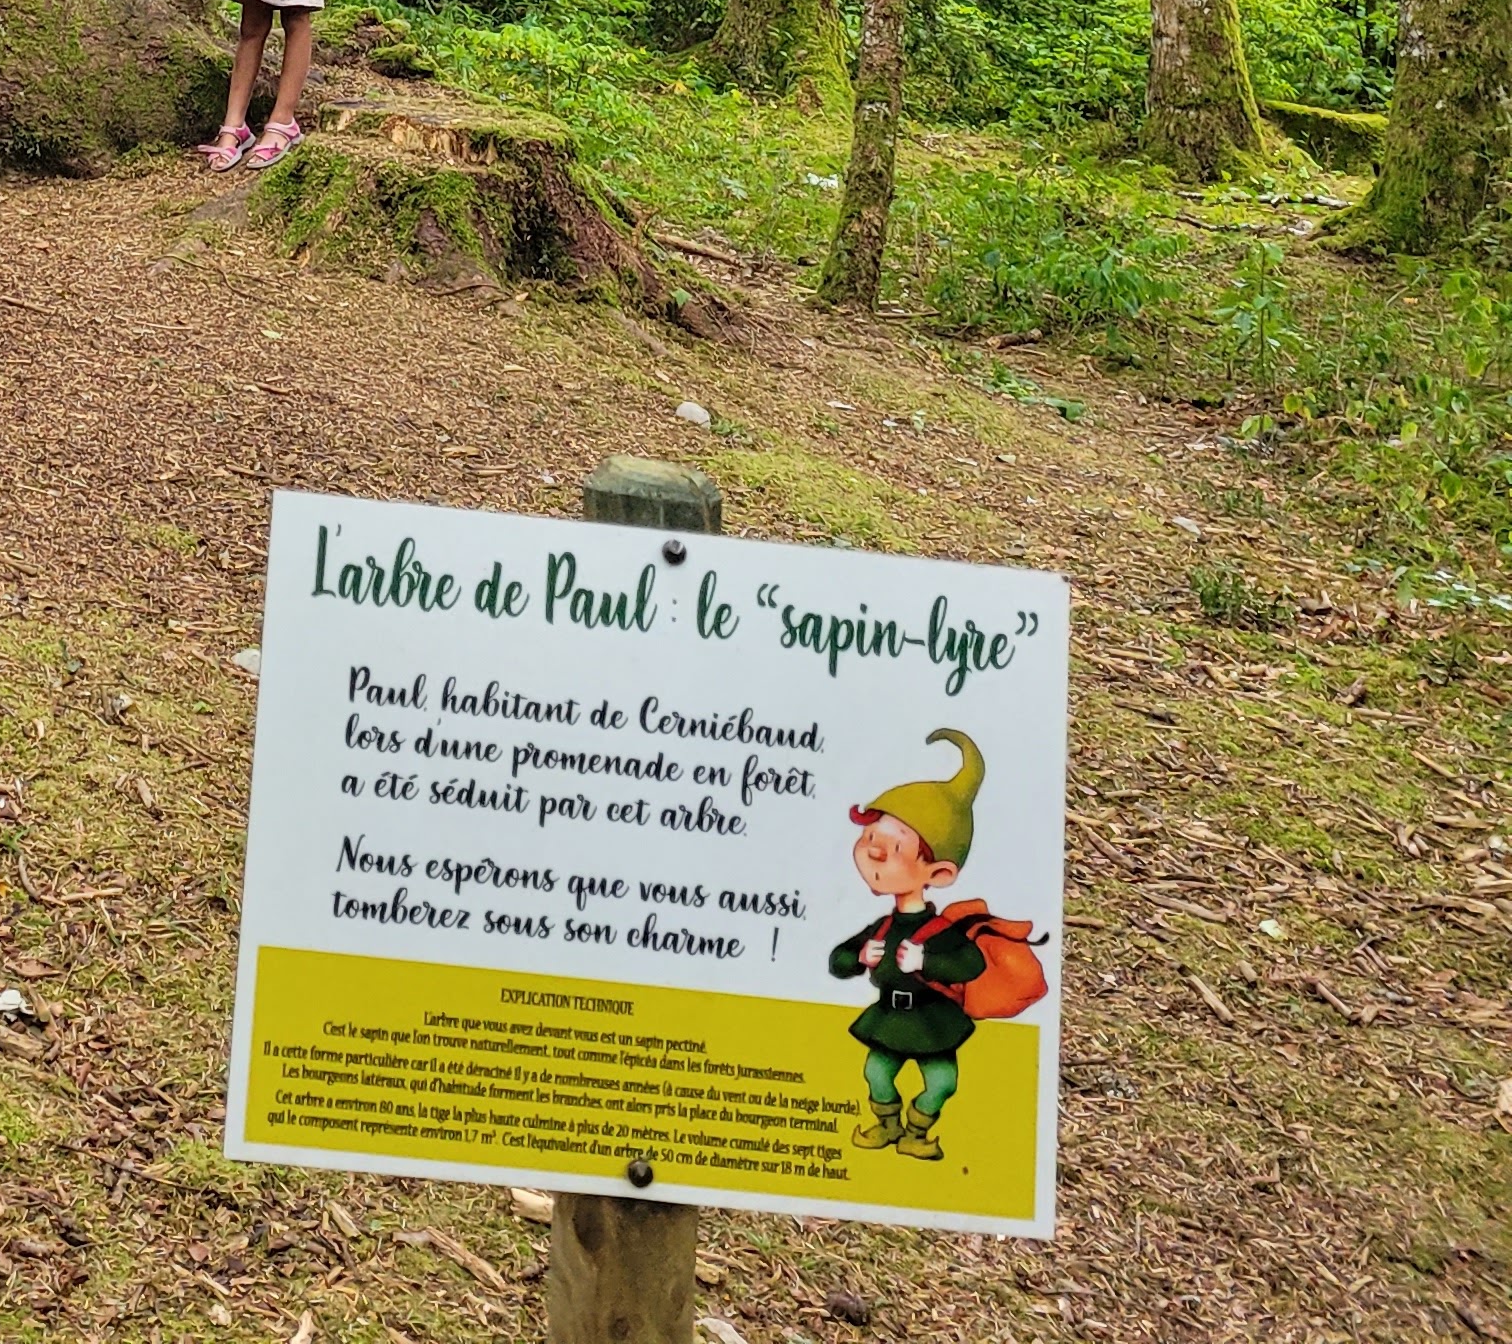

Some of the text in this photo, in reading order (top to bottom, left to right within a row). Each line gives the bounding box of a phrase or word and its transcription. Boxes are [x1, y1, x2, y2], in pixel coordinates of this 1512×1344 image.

[311, 524, 462, 612] L'arbre
[474, 561, 530, 619] de
[545, 551, 658, 633] Paul
[696, 570, 740, 640] le
[441, 676, 581, 726] habitant
[589, 699, 629, 730] de
[345, 713, 406, 754] lors
[414, 718, 503, 763] d'une
[511, 742, 684, 782] promenade
[692, 765, 732, 787] en
[341, 774, 365, 798] a
[374, 771, 420, 801] été
[429, 778, 530, 814] séduit
[538, 793, 597, 828] par
[606, 799, 651, 826] cet
[335, 834, 418, 878] Nous
[425, 857, 558, 895] espérons
[567, 875, 630, 911] que
[639, 881, 710, 908] vous
[331, 887, 779, 962] tomberez sous son charme !
[424, 1011, 460, 1029] L'arbre
[461, 1018, 482, 1032] que
[483, 1020, 508, 1033] vous
[509, 1023, 534, 1036] avez
[535, 1022, 573, 1040] devant
[574, 1029, 598, 1042] vous
[600, 1031, 616, 1045] est
[618, 1035, 633, 1046] un
[635, 1036, 664, 1052] sapin
[501, 988, 634, 1015] EXPLICATION TECHNIQUE
[264, 1040, 271, 1056] Il
[272, 1045, 280, 1057] a
[281, 1046, 308, 1059] cette
[310, 1045, 344, 1063] forme
[345, 1052, 409, 1069] particulière
[410, 1059, 428, 1072] car
[438, 1062, 445, 1073] a
[447, 1061, 464, 1075] été
[522, 1071, 530, 1084] y
[530, 1071, 538, 1083] a
[539, 1068, 553, 1084] de
[554, 1072, 620, 1091] nombreuses
[622, 1081, 660, 1095] années
[674, 1086, 705, 1099] cause
[706, 1086, 720, 1101] du
[722, 1091, 746, 1104] vent
[748, 1094, 762, 1105] ou
[764, 1091, 777, 1107] de
[779, 1092, 789, 1109] la
[791, 1097, 820, 1114] neige
[348, 1022, 358, 1038] le
[360, 1027, 389, 1043] sapin
[391, 1031, 411, 1046] que
[433, 1033, 468, 1049] trouve
[553, 1046, 576, 1060] tout
[577, 1050, 618, 1064] comme
[659, 1054, 685, 1071] dans
[687, 1057, 702, 1073] les
[703, 1059, 735, 1076] forêts
[275, 1089, 293, 1105] Cet
[294, 1091, 325, 1107] arbre
[326, 1097, 333, 1109] a
[335, 1098, 377, 1113] environ
[418, 1102, 428, 1118] la
[452, 1106, 463, 1122] la
[464, 1107, 487, 1125] plus
[489, 1109, 521, 1127] haute
[522, 1114, 567, 1132] culmine
[577, 1119, 600, 1137] plus
[601, 1121, 615, 1137] de
[616, 1124, 630, 1138] 20
[673, 1129, 686, 1144] Le
[687, 1130, 728, 1148] volume
[729, 1137, 770, 1153] cumulé
[772, 1138, 790, 1154] des
[792, 1144, 815, 1160] sept
[282, 1063, 300, 1079] Les
[302, 1064, 359, 1086] bourgeons
[410, 1079, 428, 1094] qui
[429, 1077, 487, 1097] d'habitude
[488, 1083, 534, 1102] forment
[535, 1087, 550, 1104] les
[605, 1099, 625, 1111] ont
[626, 1097, 653, 1114] alors
[654, 1103, 676, 1118] pris
[678, 1102, 688, 1118] la
[689, 1104, 717, 1122] place
[719, 1106, 733, 1122] du
[735, 1108, 787, 1130] bourgeon
[267, 1110, 285, 1127] qui
[287, 1109, 297, 1125] le
[298, 1115, 359, 1132] composent
[360, 1121, 419, 1137] représente
[420, 1126, 462, 1141] environ
[613, 1143, 644, 1159] arbre
[645, 1145, 658, 1165] de
[660, 1148, 674, 1163] 50
[676, 1152, 693, 1165] cm
[695, 1150, 708, 1166] de
[709, 1152, 760, 1171] diamètre
[761, 1161, 779, 1173] sur
[781, 1160, 792, 1175] 18
[794, 1164, 805, 1176] m
[807, 1162, 821, 1178] de
